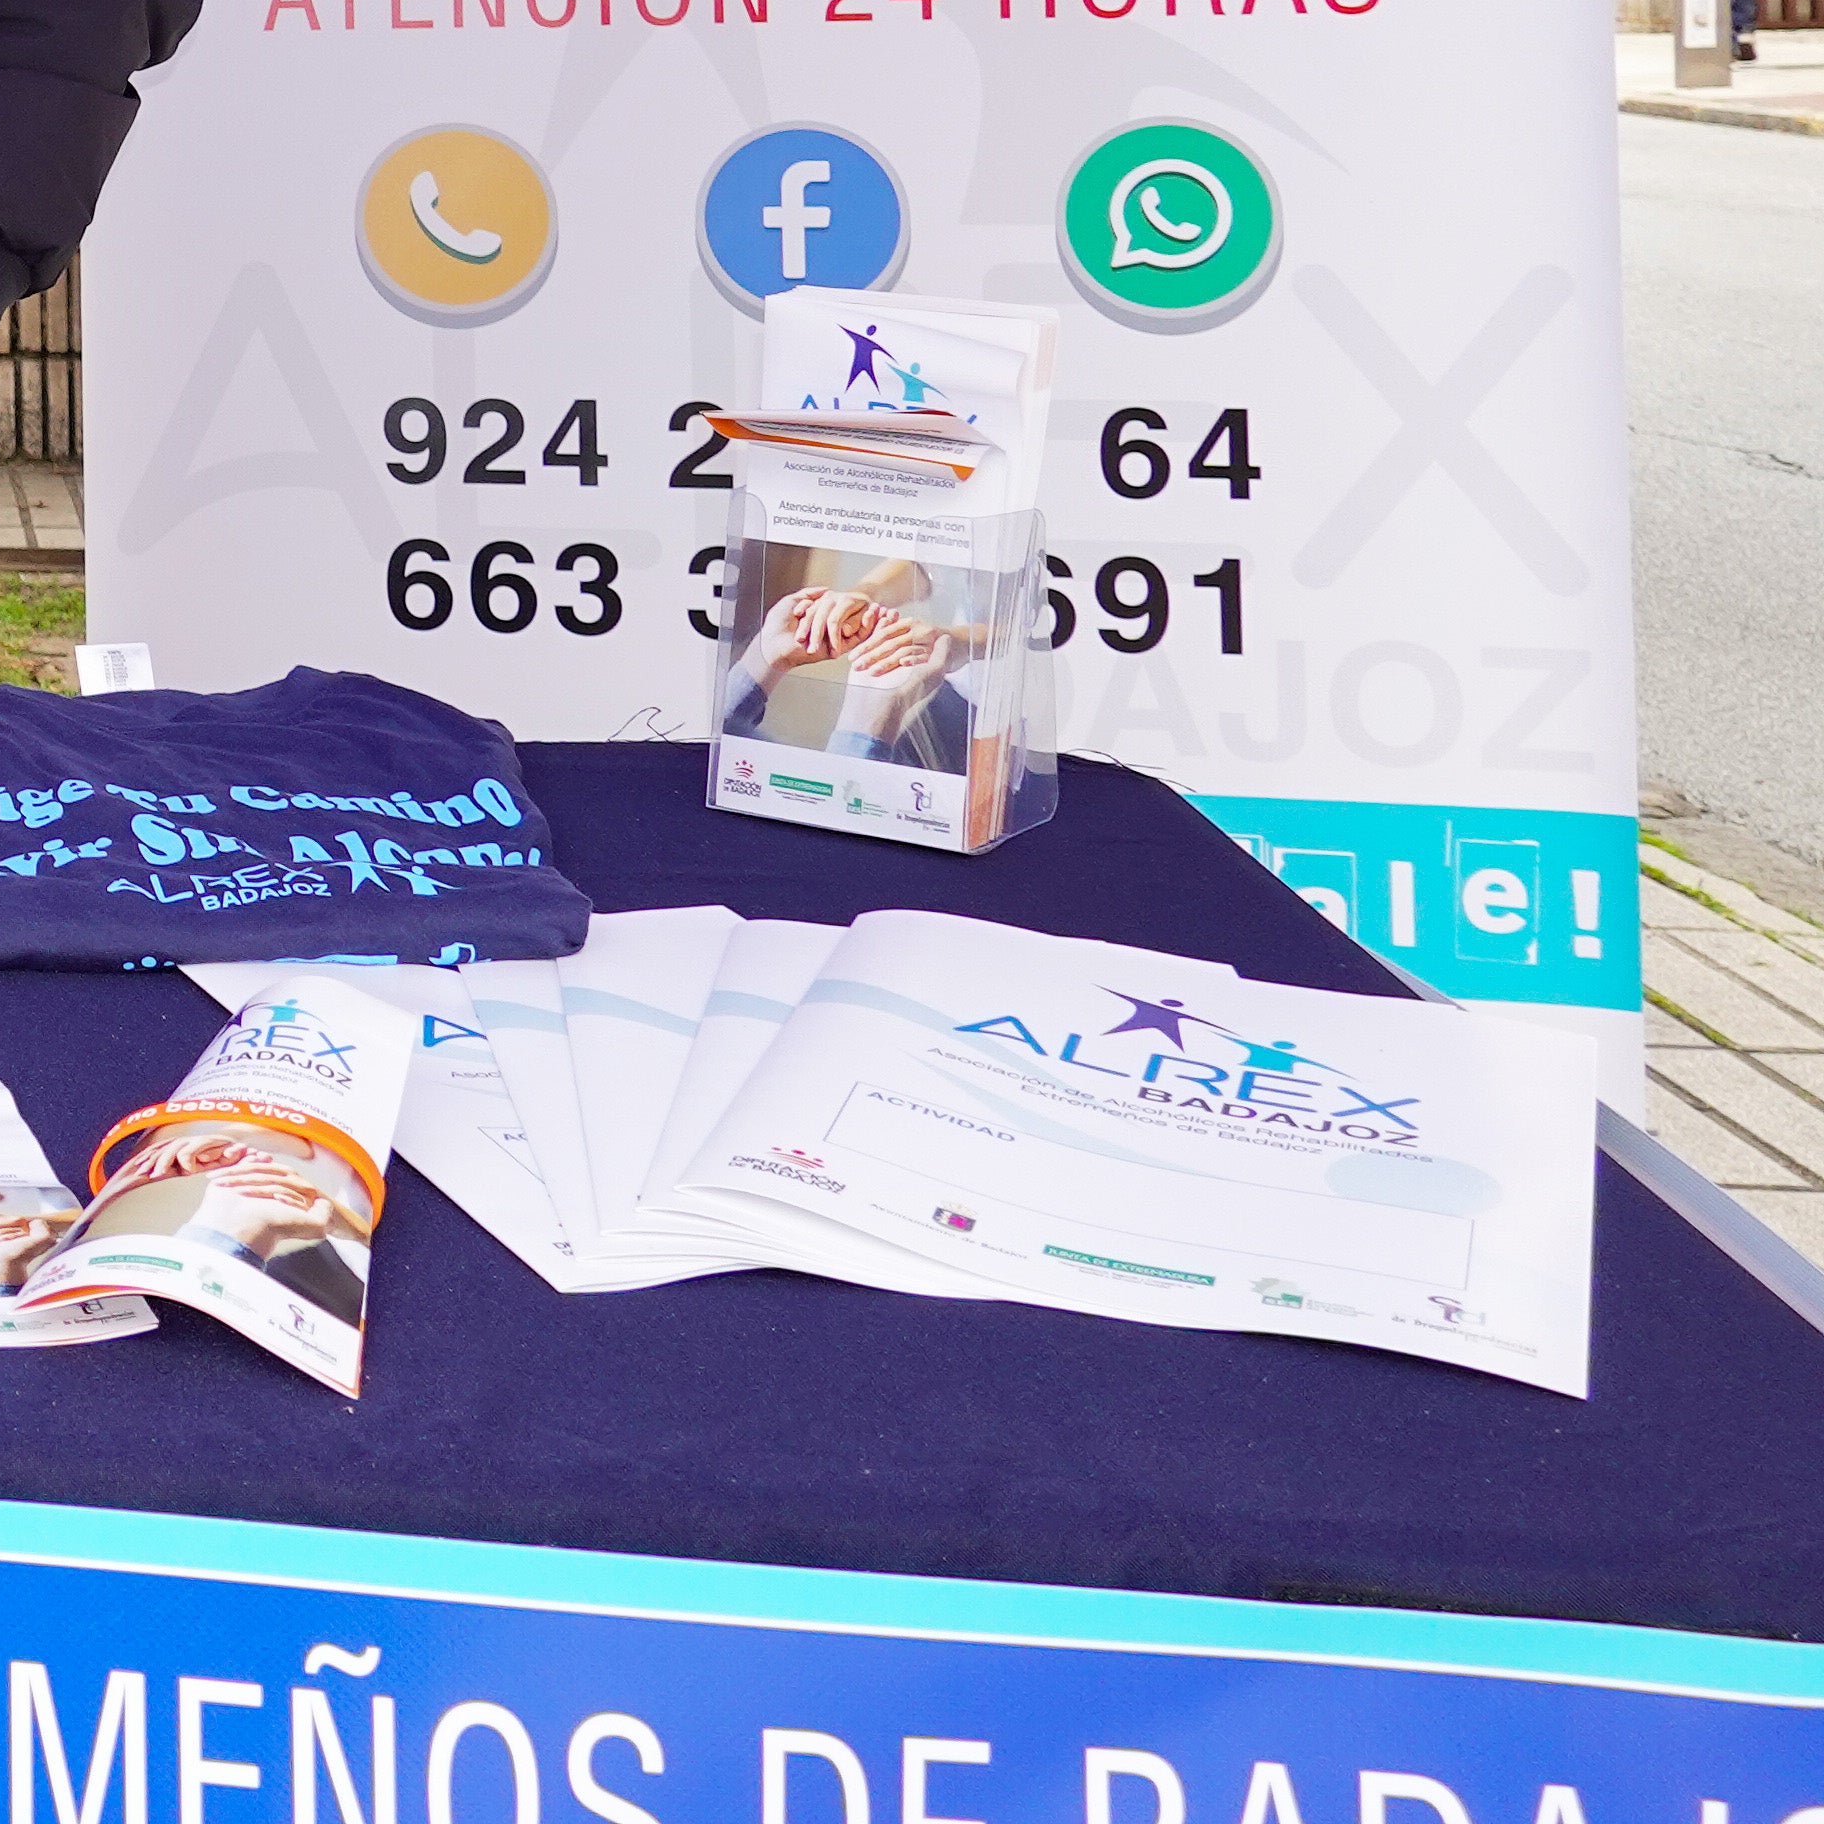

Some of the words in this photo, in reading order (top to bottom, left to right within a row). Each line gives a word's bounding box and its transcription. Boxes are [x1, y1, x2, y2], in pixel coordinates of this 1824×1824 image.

[382, 398, 610, 489] 924
[668, 400, 734, 489] 2
[1099, 407, 1262, 501] 64
[784, 460, 831, 477] Asociación
[833, 466, 846, 477] de
[847, 466, 895, 483] Alcohólicos
[897, 472, 956, 489] Rehabilitados
[818, 478, 869, 493] Extremeños
[871, 484, 882, 494] de
[883, 483, 919, 499] Badajoz
[773, 515, 824, 533] problemas
[827, 520, 839, 532] de
[841, 522, 876, 538] alcohol
[877, 528, 884, 540] y
[886, 528, 893, 538] a
[895, 531, 914, 542] sus
[916, 532, 970, 550] familiares
[779, 500, 823, 516] Atención
[825, 506, 882, 523] ambulatoria
[884, 513, 891, 523] a
[893, 515, 941, 532] personas
[944, 522, 966, 534] con
[384, 538, 625, 636] 663
[227, 776, 526, 830] Camino
[201, 881, 332, 913] BADAJOZ
[216, 1051, 353, 1090] BADAJOZ
[952, 1015, 1421, 1131] ALREX
[127, 1107, 157, 1123] no
[165, 1099, 240, 1114] bebo,
[249, 1104, 306, 1126] vivo
[866, 1089, 1016, 1143] ACTIVIDAD
[927, 1046, 1054, 1092] Asociación
[1062, 1087, 1097, 1101] de
[1103, 1094, 1249, 1134] Alcohólicos
[1255, 1126, 1435, 1165] Rehabilitados
[1020, 1084, 1171, 1128] Extremeños
[1176, 1122, 1209, 1136] de
[1218, 1128, 1322, 1158] Badajoz
[1136, 1086, 1421, 1149] BADAJOZ
[728, 1160, 747, 1169] DE
[750, 1163, 845, 1195] BADAJOZ
[731, 1154, 846, 1189] DIPUTACIÓN
